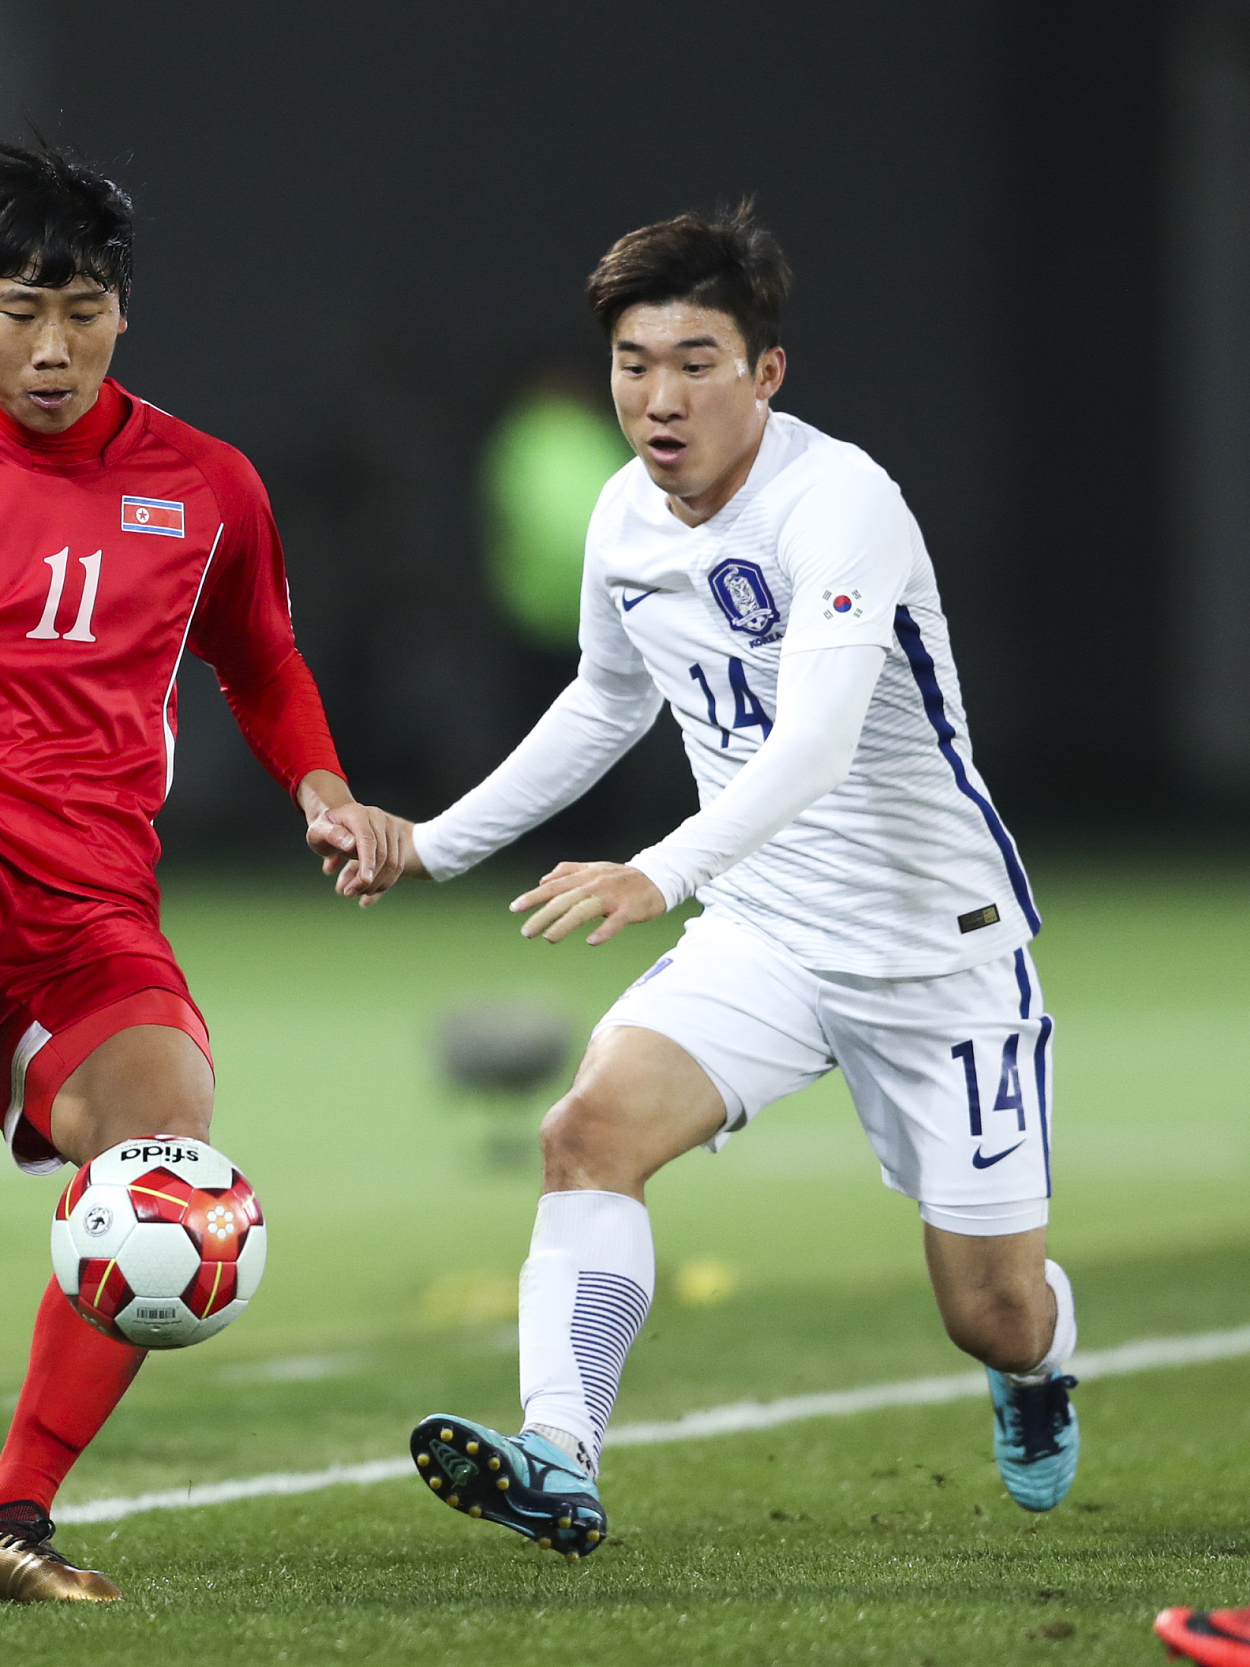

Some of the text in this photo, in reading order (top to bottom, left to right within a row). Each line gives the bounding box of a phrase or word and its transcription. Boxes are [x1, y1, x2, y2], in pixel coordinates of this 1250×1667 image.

[25, 546, 102, 643] 11
[749, 631, 784, 649] KOREA
[688, 656, 774, 749] 14
[951, 1033, 1026, 1137] 14
[120, 1145, 199, 1163] sfida
